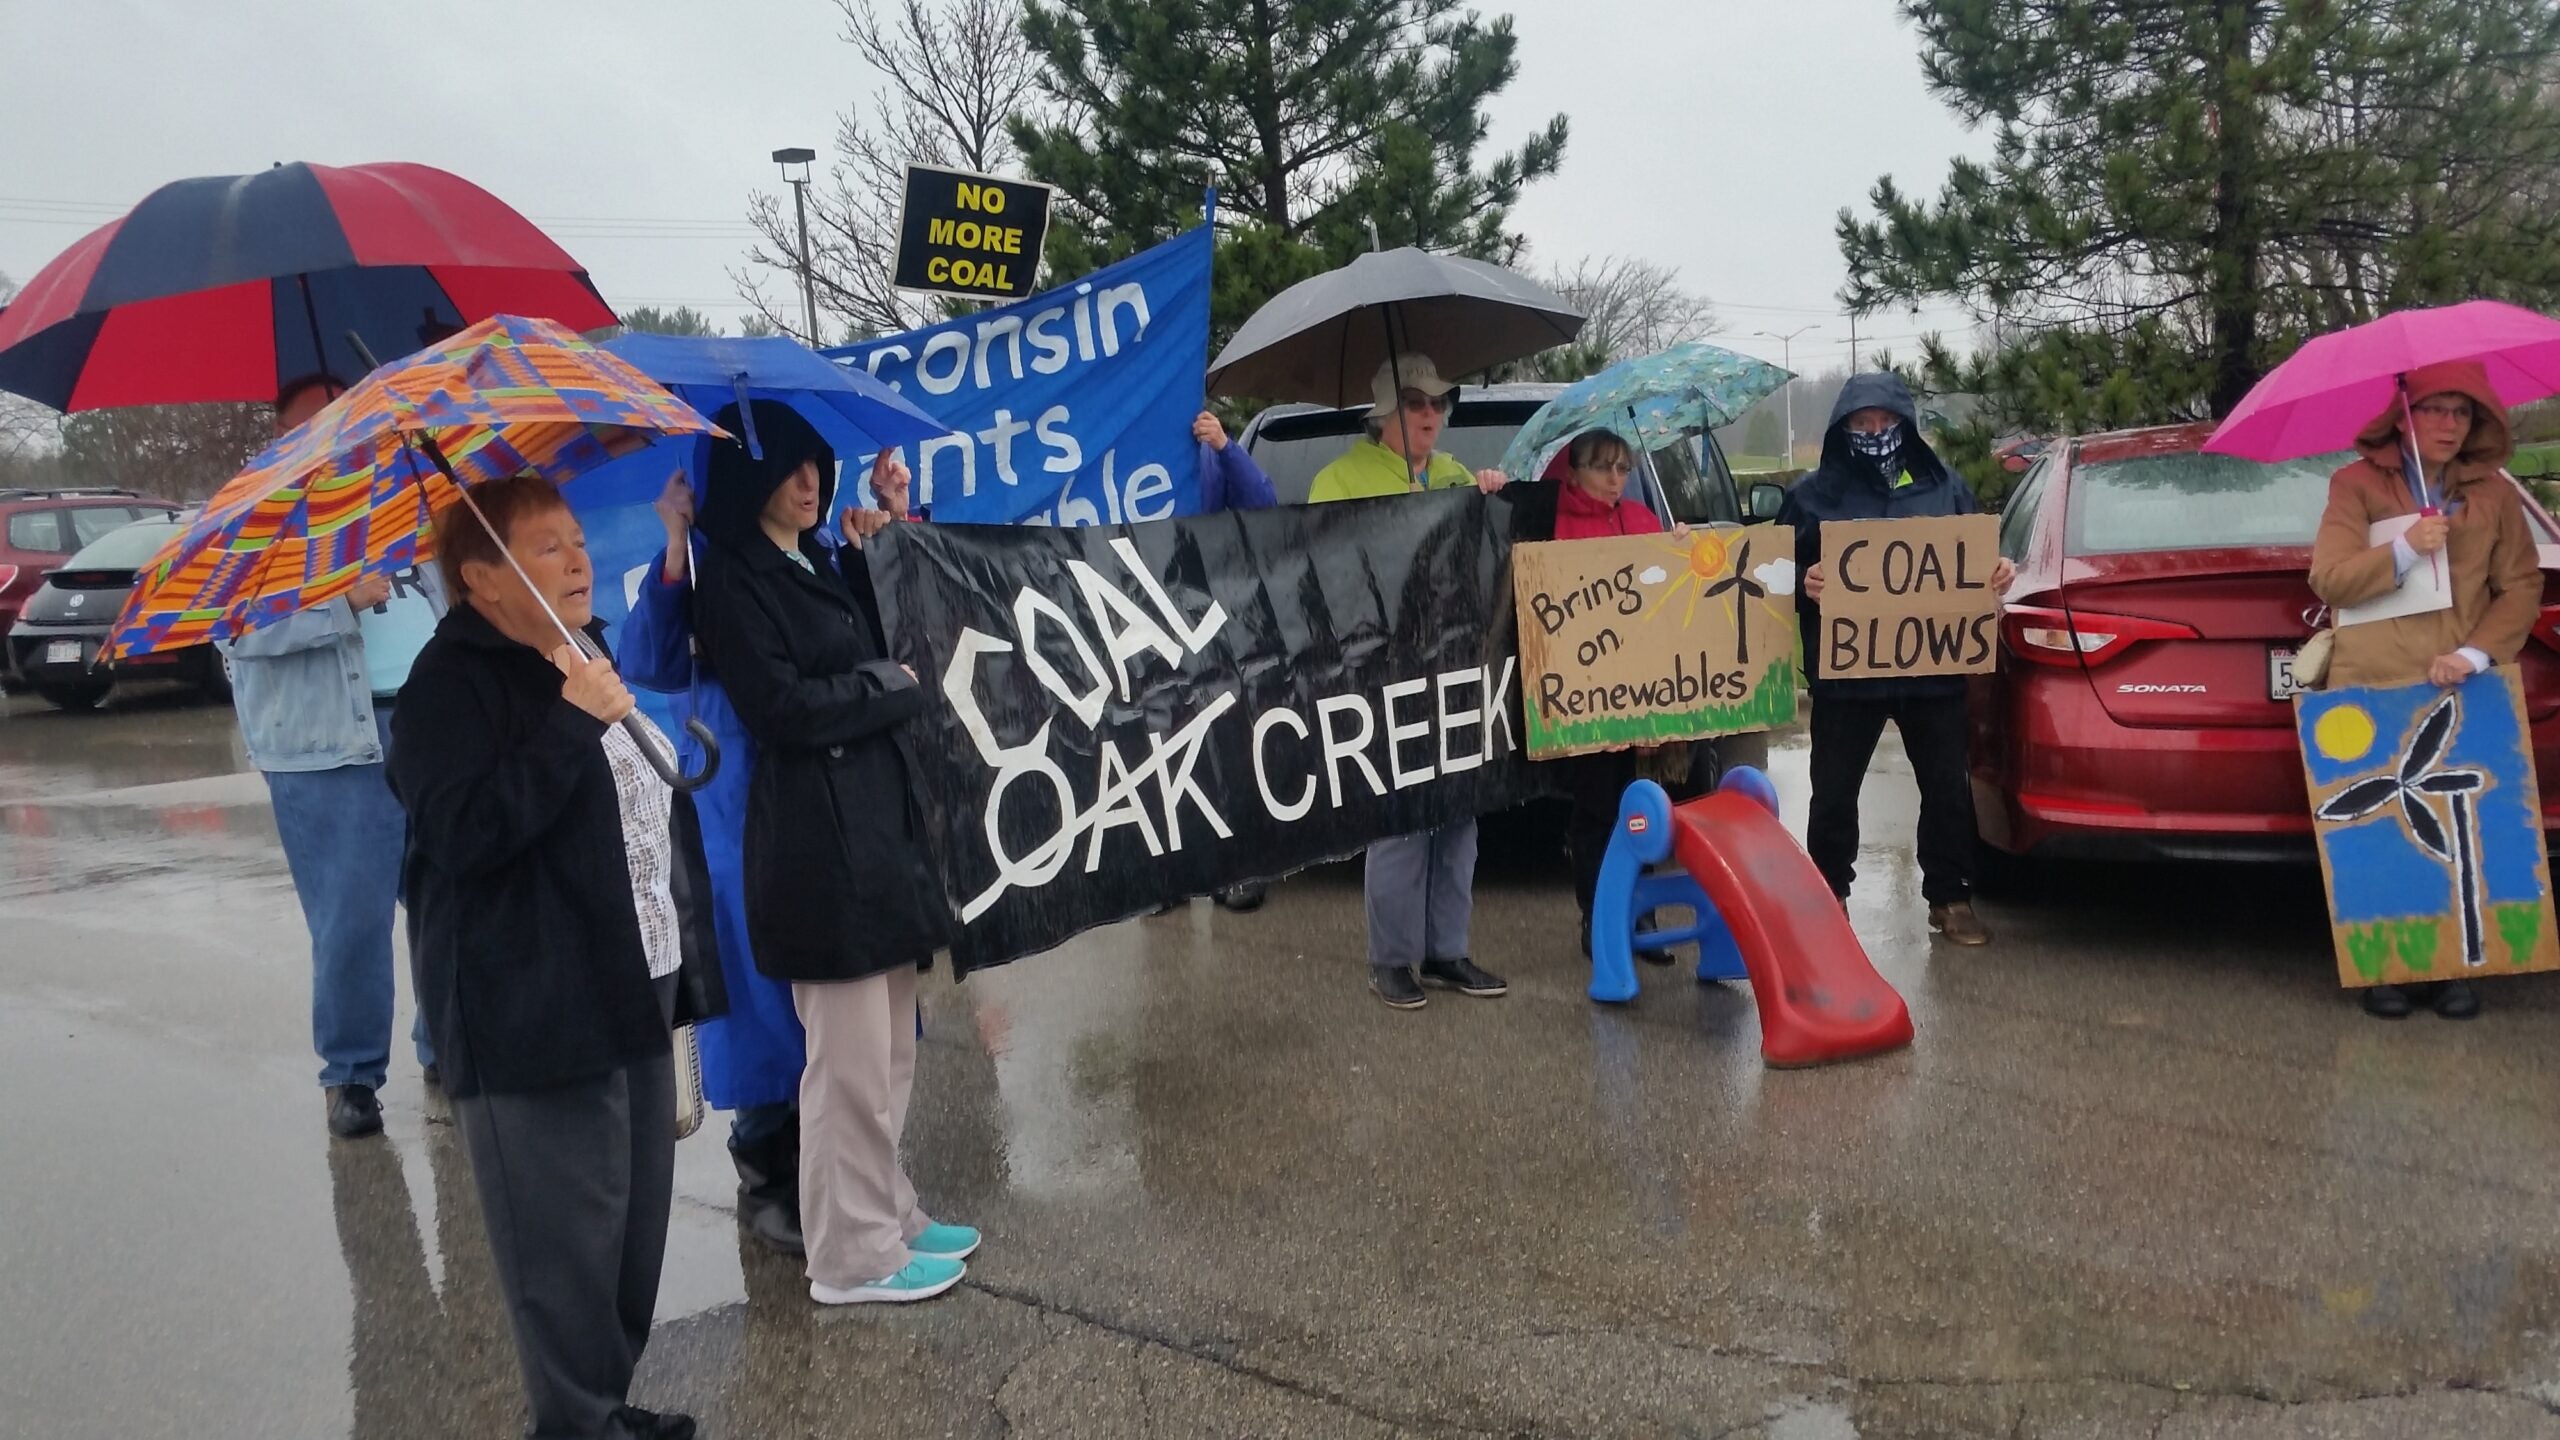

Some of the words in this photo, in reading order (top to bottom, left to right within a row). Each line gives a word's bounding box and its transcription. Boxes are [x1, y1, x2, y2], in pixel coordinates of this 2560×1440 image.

[956, 182, 1005, 214] NO
[928, 218, 1023, 254] MORE
[927, 256, 1014, 290] COAL
[831, 281, 1151, 396] consin
[1838, 539, 1986, 596] COAL
[1530, 563, 1643, 635] Bring
[942, 537, 1228, 767] COAL
[1577, 628, 1620, 666] on
[1830, 612, 1996, 671] BLOWS
[1540, 651, 1748, 719] Renewables
[2116, 684, 2207, 693] SONATA
[978, 692, 1236, 890] OAK
[1252, 656, 1517, 823] CREEK
